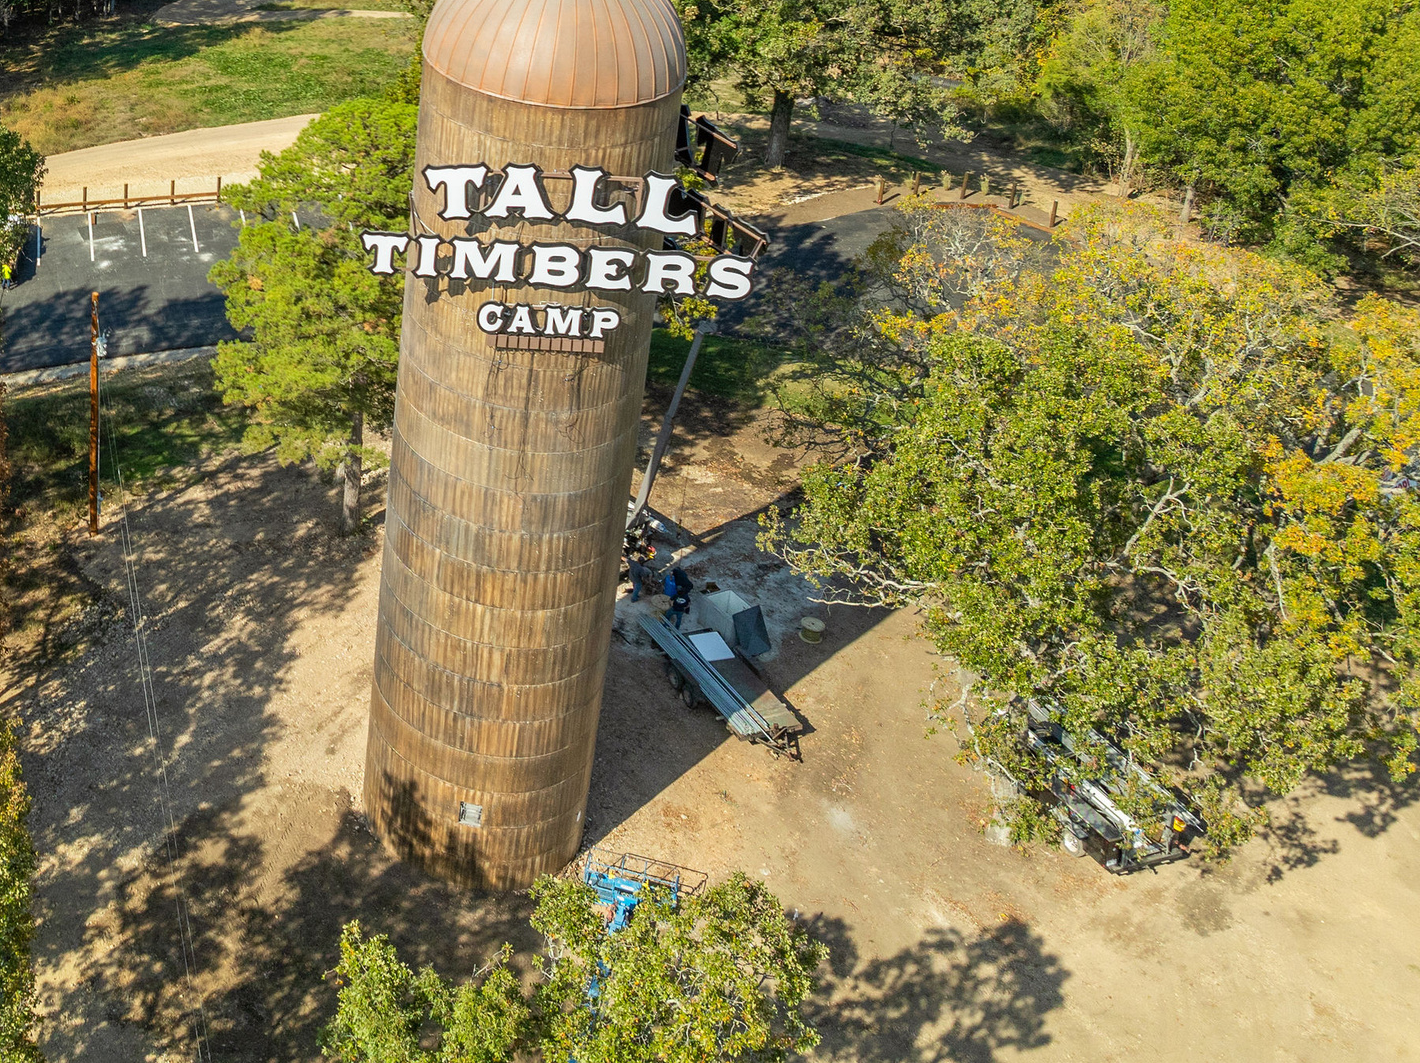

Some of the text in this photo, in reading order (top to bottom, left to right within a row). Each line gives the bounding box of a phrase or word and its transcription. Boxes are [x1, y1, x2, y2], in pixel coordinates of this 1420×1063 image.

[422, 162, 699, 237] TALL
[360, 230, 756, 300] TIMBERS
[478, 302, 622, 339] CAMP
